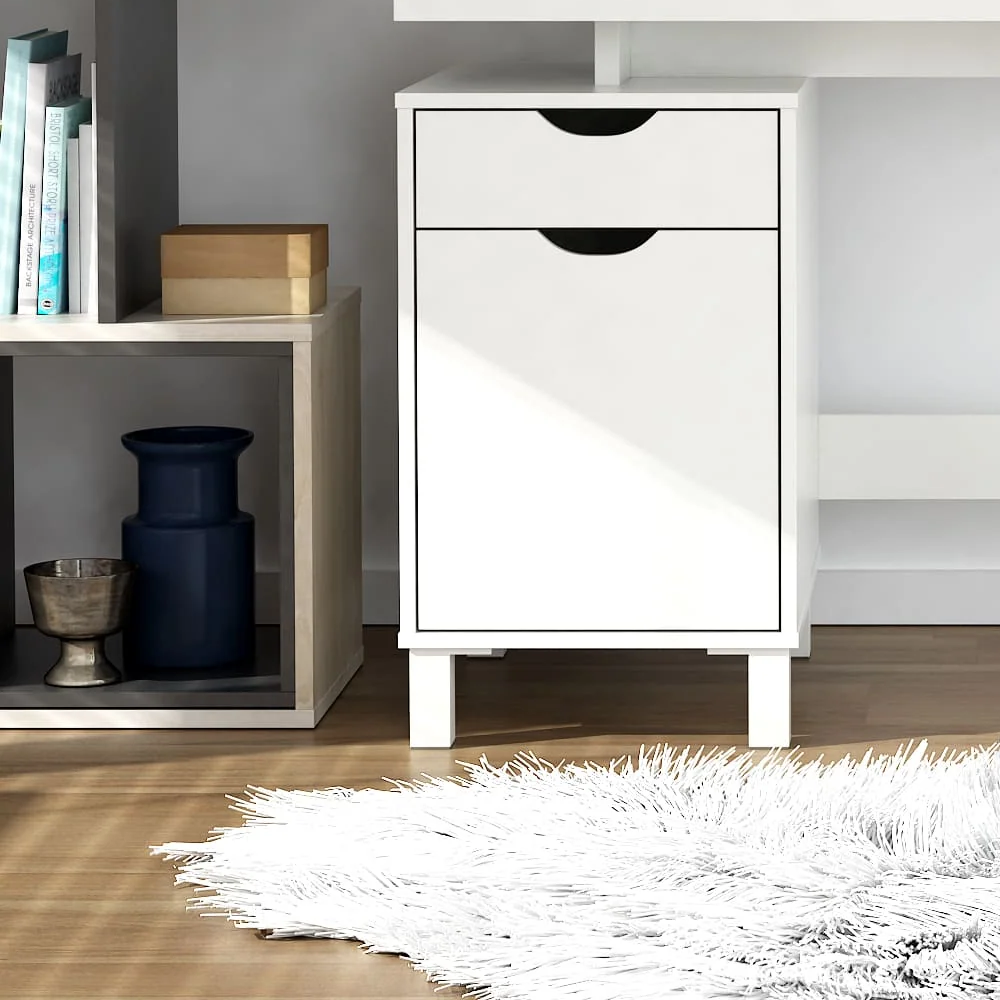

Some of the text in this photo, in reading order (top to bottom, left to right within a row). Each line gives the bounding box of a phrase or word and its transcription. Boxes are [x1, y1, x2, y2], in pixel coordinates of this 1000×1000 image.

[48, 112, 61, 146] BRISTOL
[47, 150, 60, 179] SHORT
[27, 183, 36, 240] ARCHITECTURE
[44, 212, 57, 235] PRIZE
